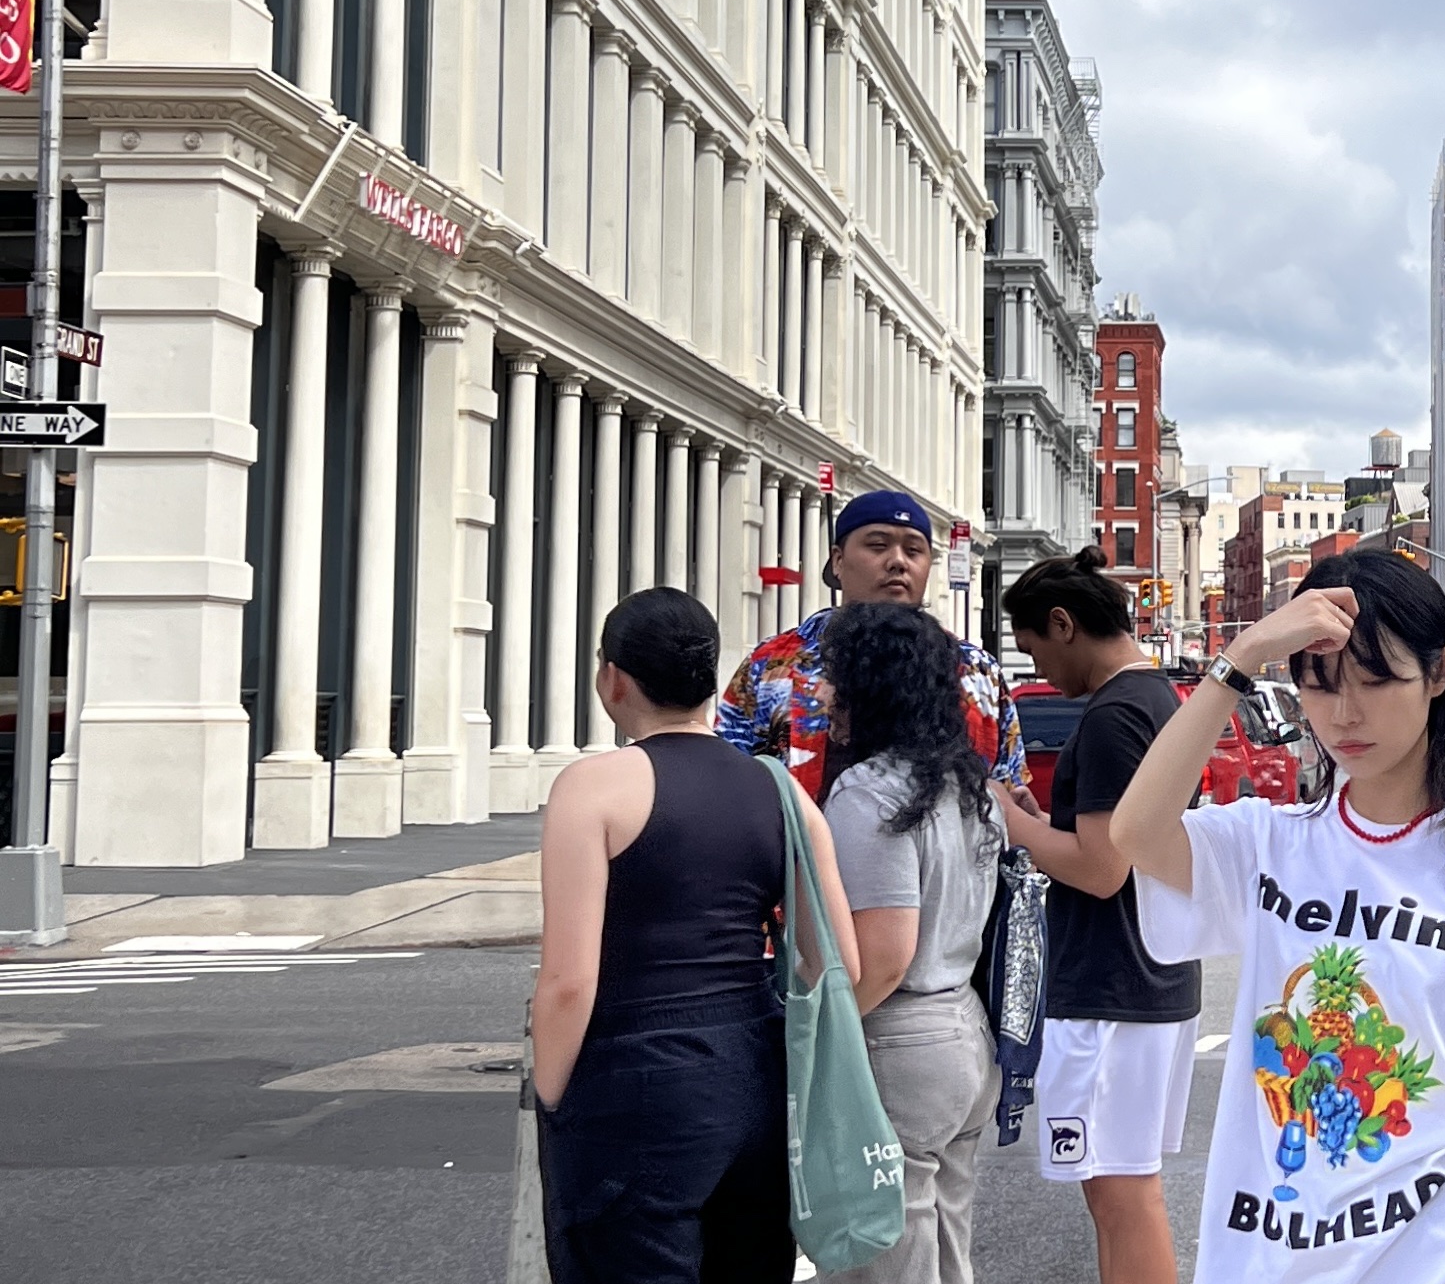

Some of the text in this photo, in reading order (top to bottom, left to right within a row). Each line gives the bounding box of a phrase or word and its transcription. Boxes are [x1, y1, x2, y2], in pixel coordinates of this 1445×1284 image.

[360, 171, 465, 260] WELLS FARGO
[57, 326, 100, 362] RAND ST
[45, 416, 85, 433] WAY
